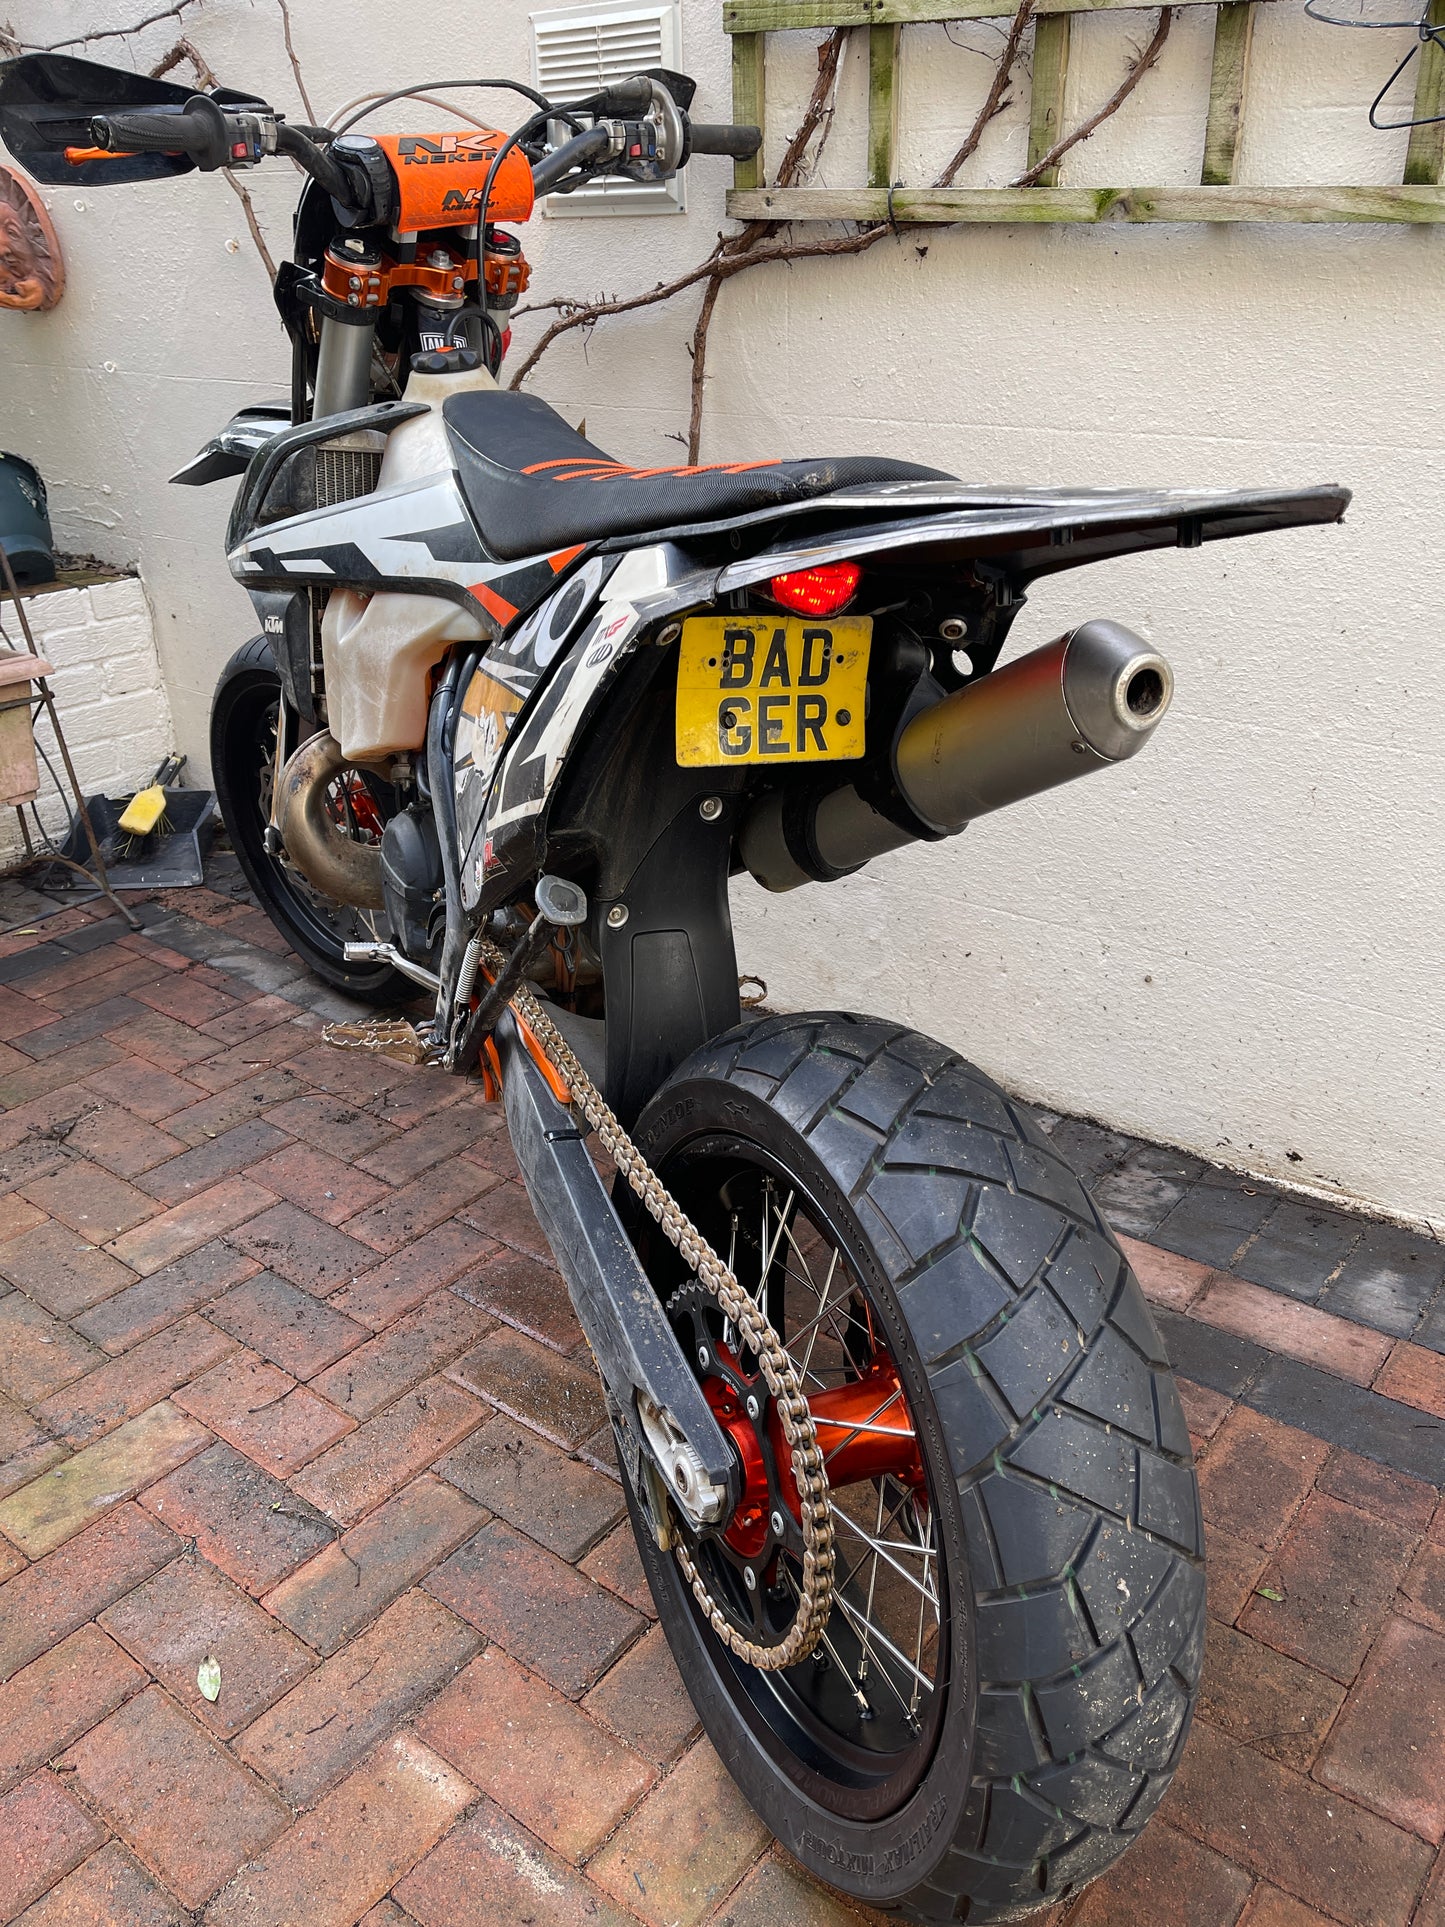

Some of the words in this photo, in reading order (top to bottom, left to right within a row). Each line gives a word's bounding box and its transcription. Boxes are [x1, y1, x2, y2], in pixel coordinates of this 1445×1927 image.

[398, 133, 497, 155] NK
[264, 615, 284, 634] KTM
[719, 628, 833, 689] BAD
[718, 694, 828, 756] GER
[645, 1097, 695, 1150] DUNLOP
